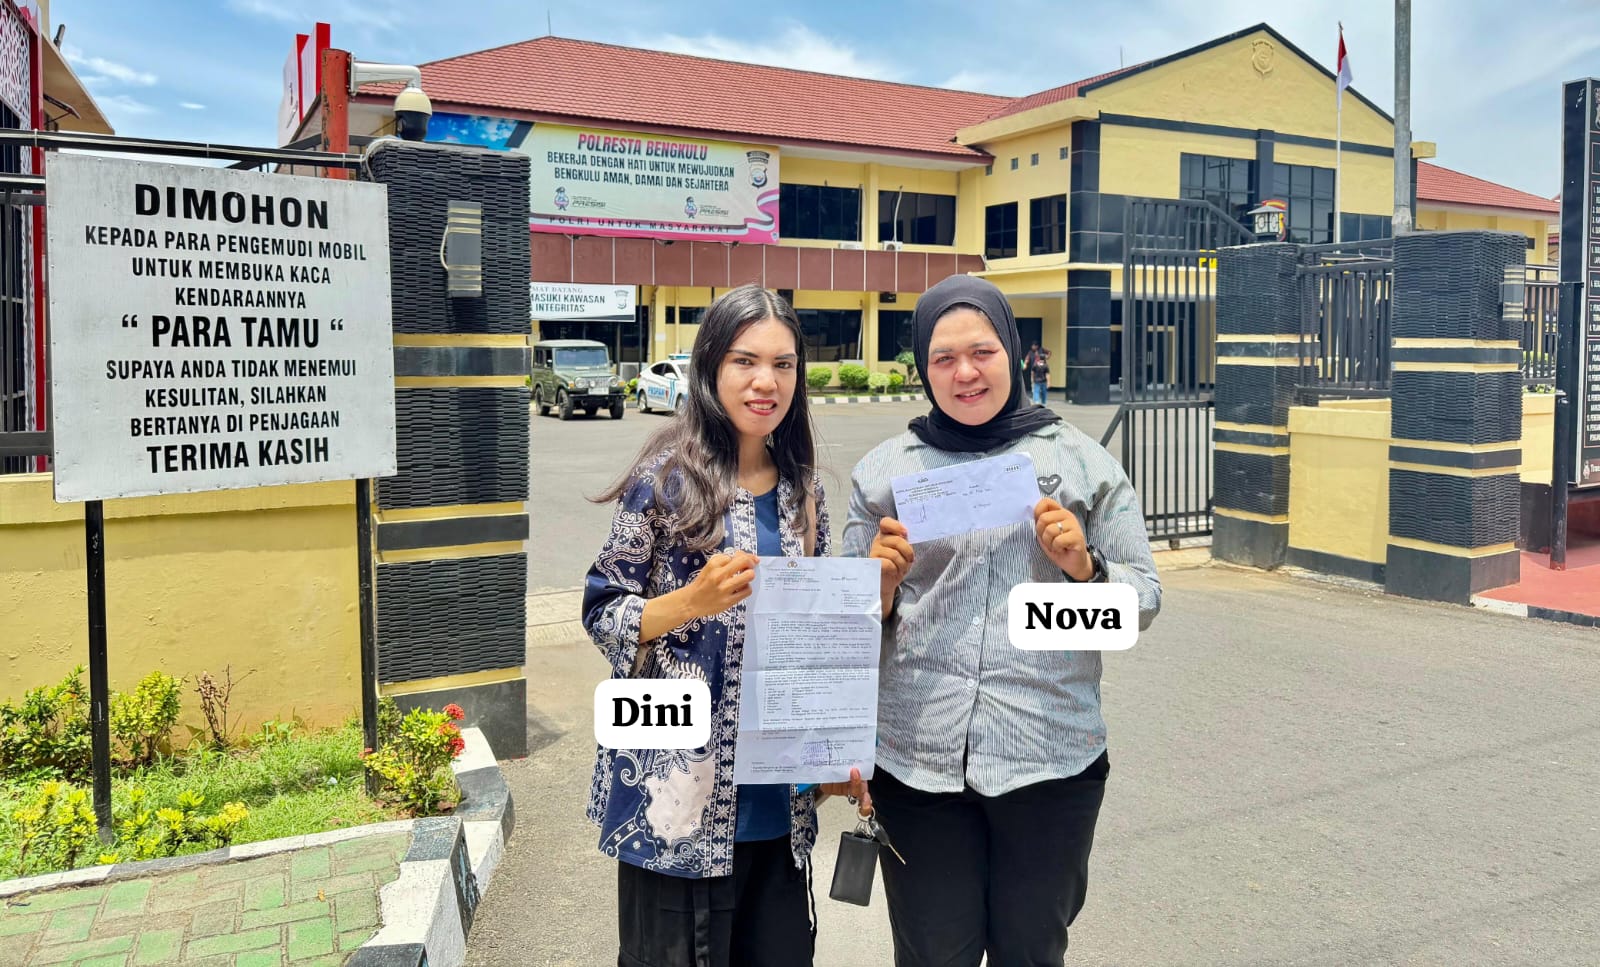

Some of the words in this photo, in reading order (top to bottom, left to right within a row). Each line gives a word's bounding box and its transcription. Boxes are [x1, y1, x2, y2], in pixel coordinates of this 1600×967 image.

[578, 133, 641, 156] POLRESTA
[646, 141, 708, 160] BENGKULU
[548, 152, 587, 166] BEKERJA
[590, 155, 625, 169] DENGAN
[628, 158, 646, 171] HATI
[650, 161, 676, 173] UNTUK
[678, 163, 734, 177] MEWUJUDKAN
[555, 167, 600, 182] BENGKULU
[604, 172, 632, 186] AMAN,
[636, 175, 663, 187] DAMAI
[666, 177, 682, 188] DAN
[685, 178, 729, 191] SEJAHTERA
[135, 183, 329, 229] DIMOHON
[550, 217, 590, 225] POLRI
[598, 219, 641, 228] UNTUK
[651, 222, 730, 233] MASYARAKAT
[86, 225, 157, 248] KEPADA
[165, 232, 209, 251] PARA
[217, 235, 313, 258] PENGEMUDI
[319, 242, 367, 261] MOBIL
[133, 257, 192, 278] UNTUK
[200, 261, 284, 282] MEMBUKA
[290, 267, 331, 284] KACA
[176, 288, 306, 309] KENDARAANNYA
[536, 304, 585, 312] INTEGRITAS
[564, 295, 605, 303] KAWASAN
[152, 315, 231, 347] PARA
[241, 317, 319, 348] TAMU
[106, 360, 175, 379] SUPAYA
[181, 360, 225, 378] ANDA
[232, 360, 278, 377] TIDAK
[285, 360, 356, 376] MENEMUI
[146, 387, 245, 408] KESULITAN,
[251, 386, 326, 404] SILAHKAN
[131, 415, 220, 437] BERTANYA
[227, 414, 242, 432] DI
[250, 411, 339, 431] PENJAGAAN
[147, 444, 249, 473] TERIMA
[259, 437, 329, 466] KASIH
